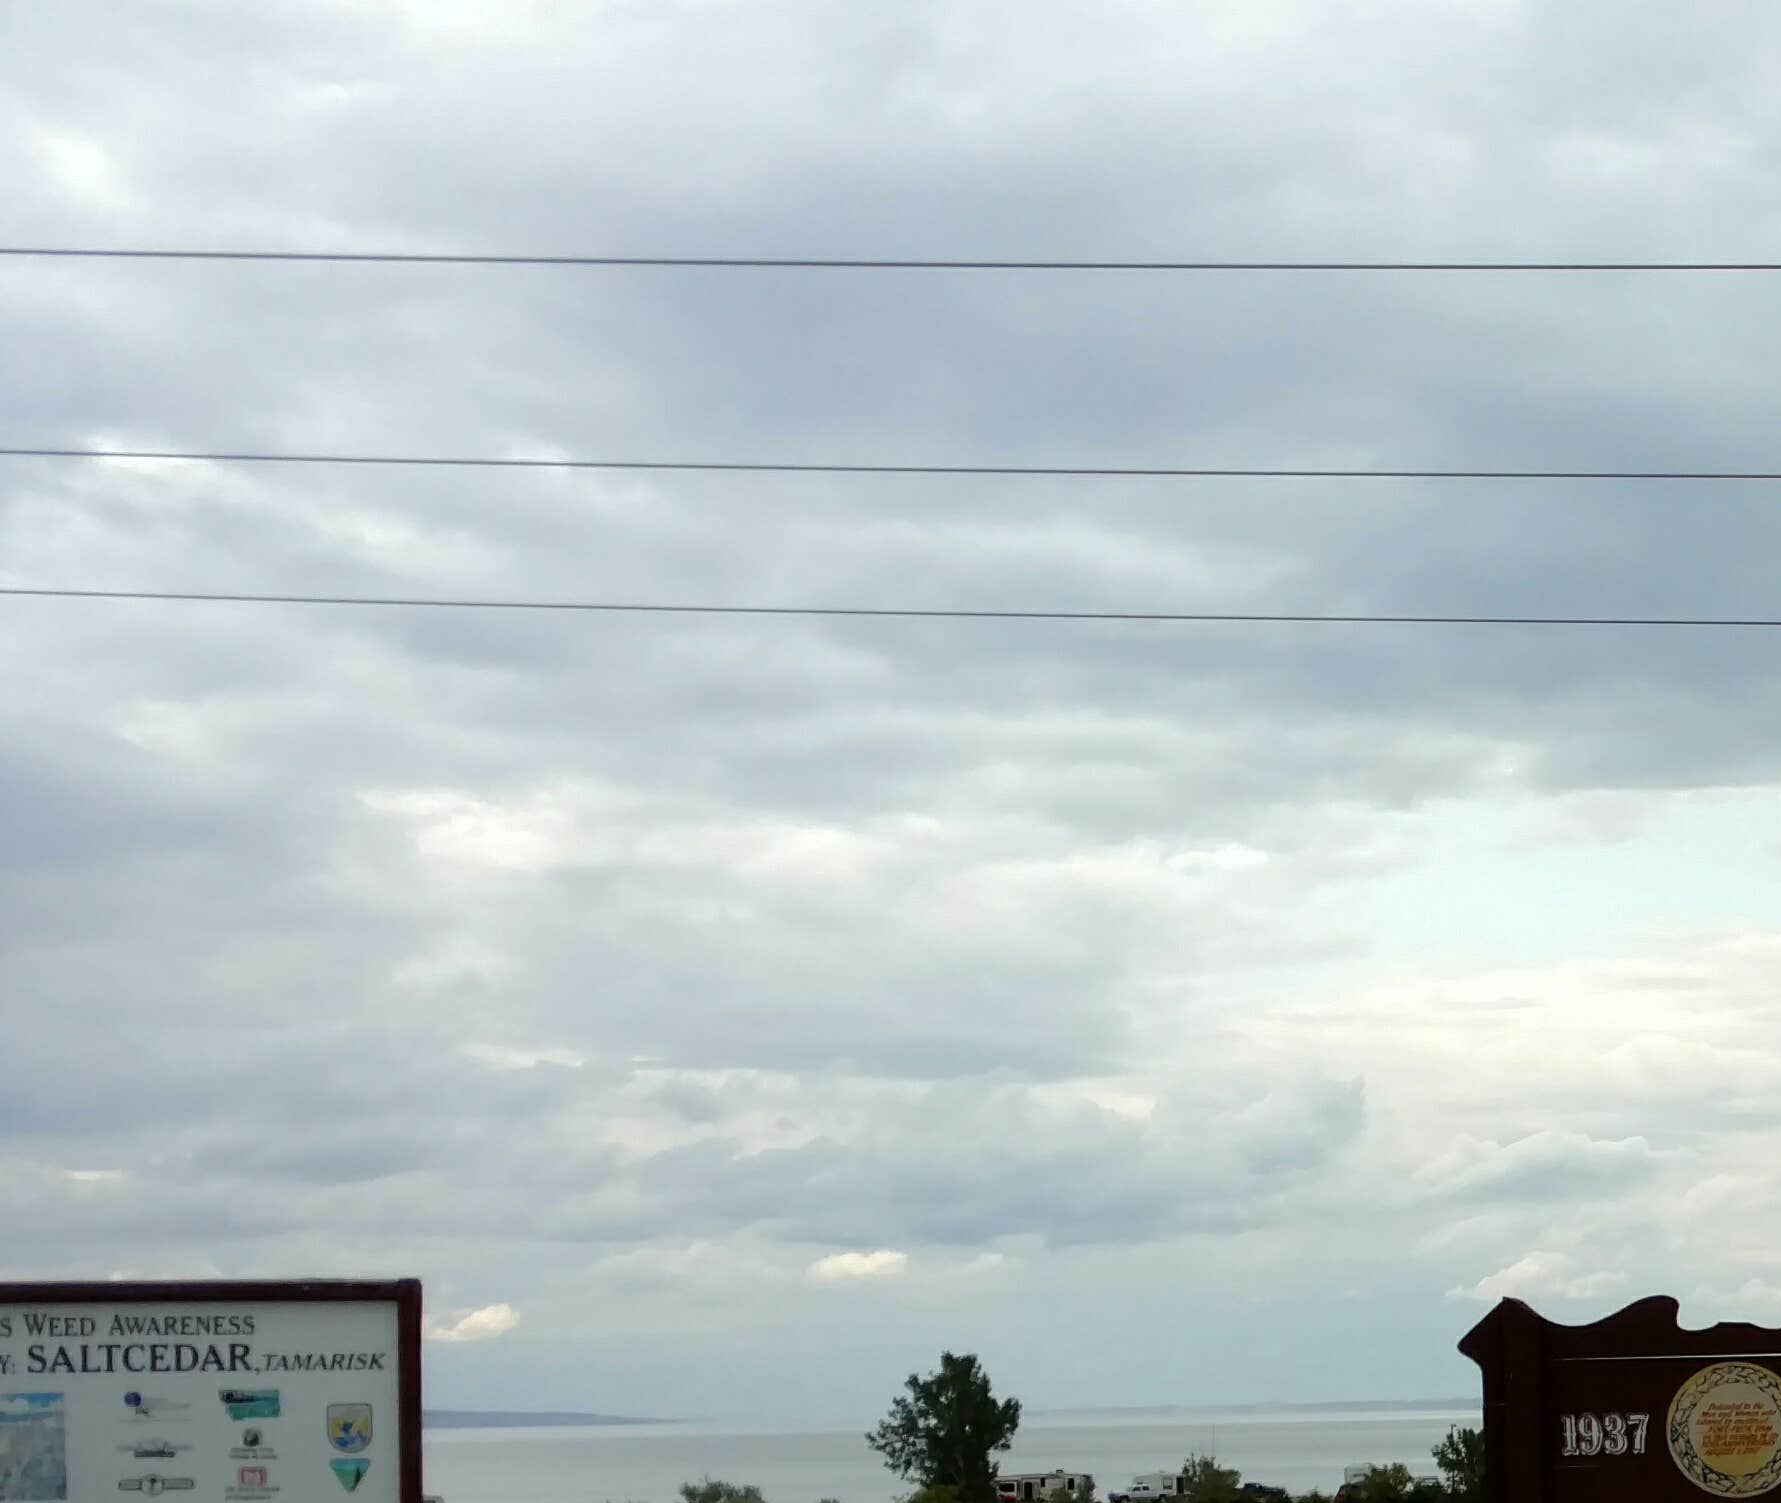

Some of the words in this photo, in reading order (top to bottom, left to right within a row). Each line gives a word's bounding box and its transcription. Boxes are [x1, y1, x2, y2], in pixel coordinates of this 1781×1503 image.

[24, 1314, 96, 1337] WEED
[109, 1314, 255, 1336] AWARENESS
[27, 1344, 261, 1373] SALTCEDAR,
[261, 1352, 387, 1371] TAMARISK
[1561, 1412, 1650, 1457] 1937
